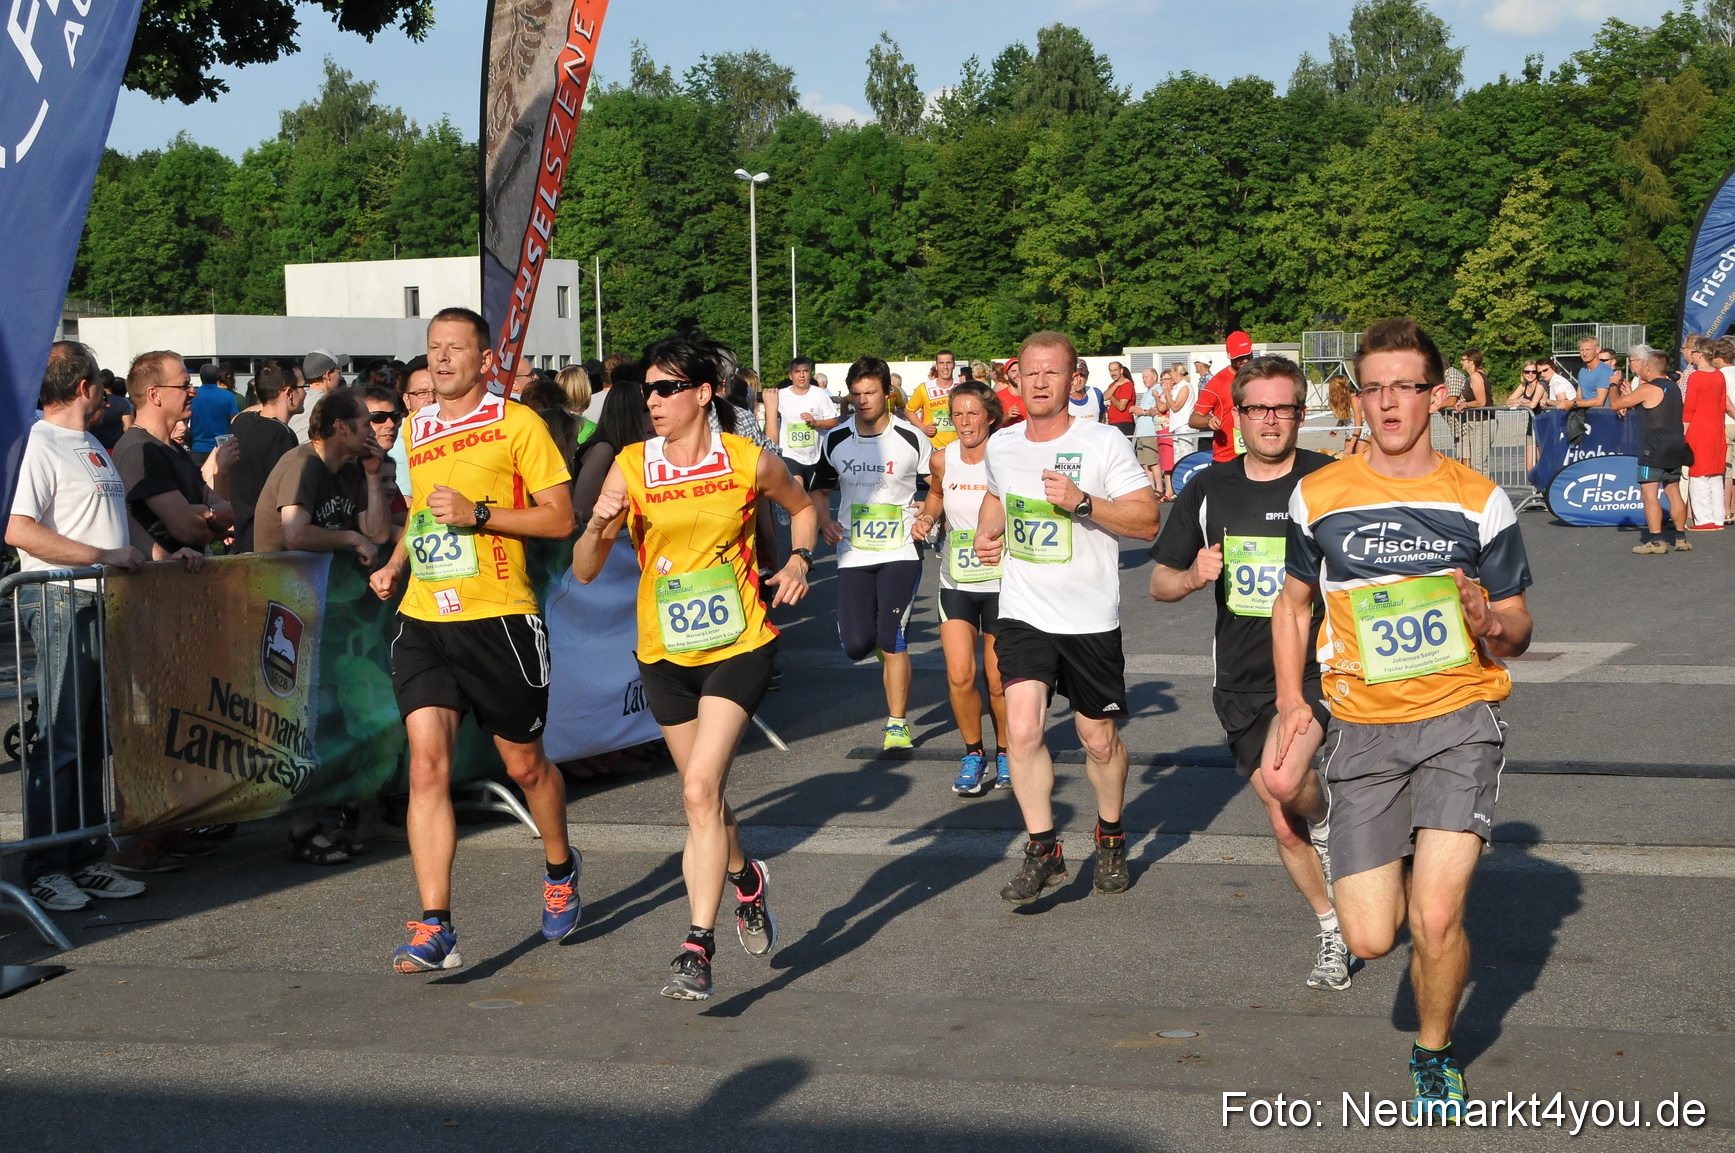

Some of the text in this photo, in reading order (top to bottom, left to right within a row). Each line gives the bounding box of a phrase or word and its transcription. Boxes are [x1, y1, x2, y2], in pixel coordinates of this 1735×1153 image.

[791, 431, 811, 442] 896
[409, 428, 507, 469] MAX BÖGL
[842, 459, 895, 475] Xplus1
[645, 479, 739, 504] MAX BÖGL
[852, 520, 900, 539] 1427
[1013, 518, 1059, 547] 872
[412, 532, 462, 564] 823
[1364, 536, 1458, 555] Fischer
[1374, 552, 1452, 564] AUTOMOBILE
[667, 594, 729, 634] 826
[1371, 608, 1448, 657] 396
[1384, 655, 1451, 673] Fischer Automobile GmbH
[1392, 650, 1440, 664] Johannes Saager
